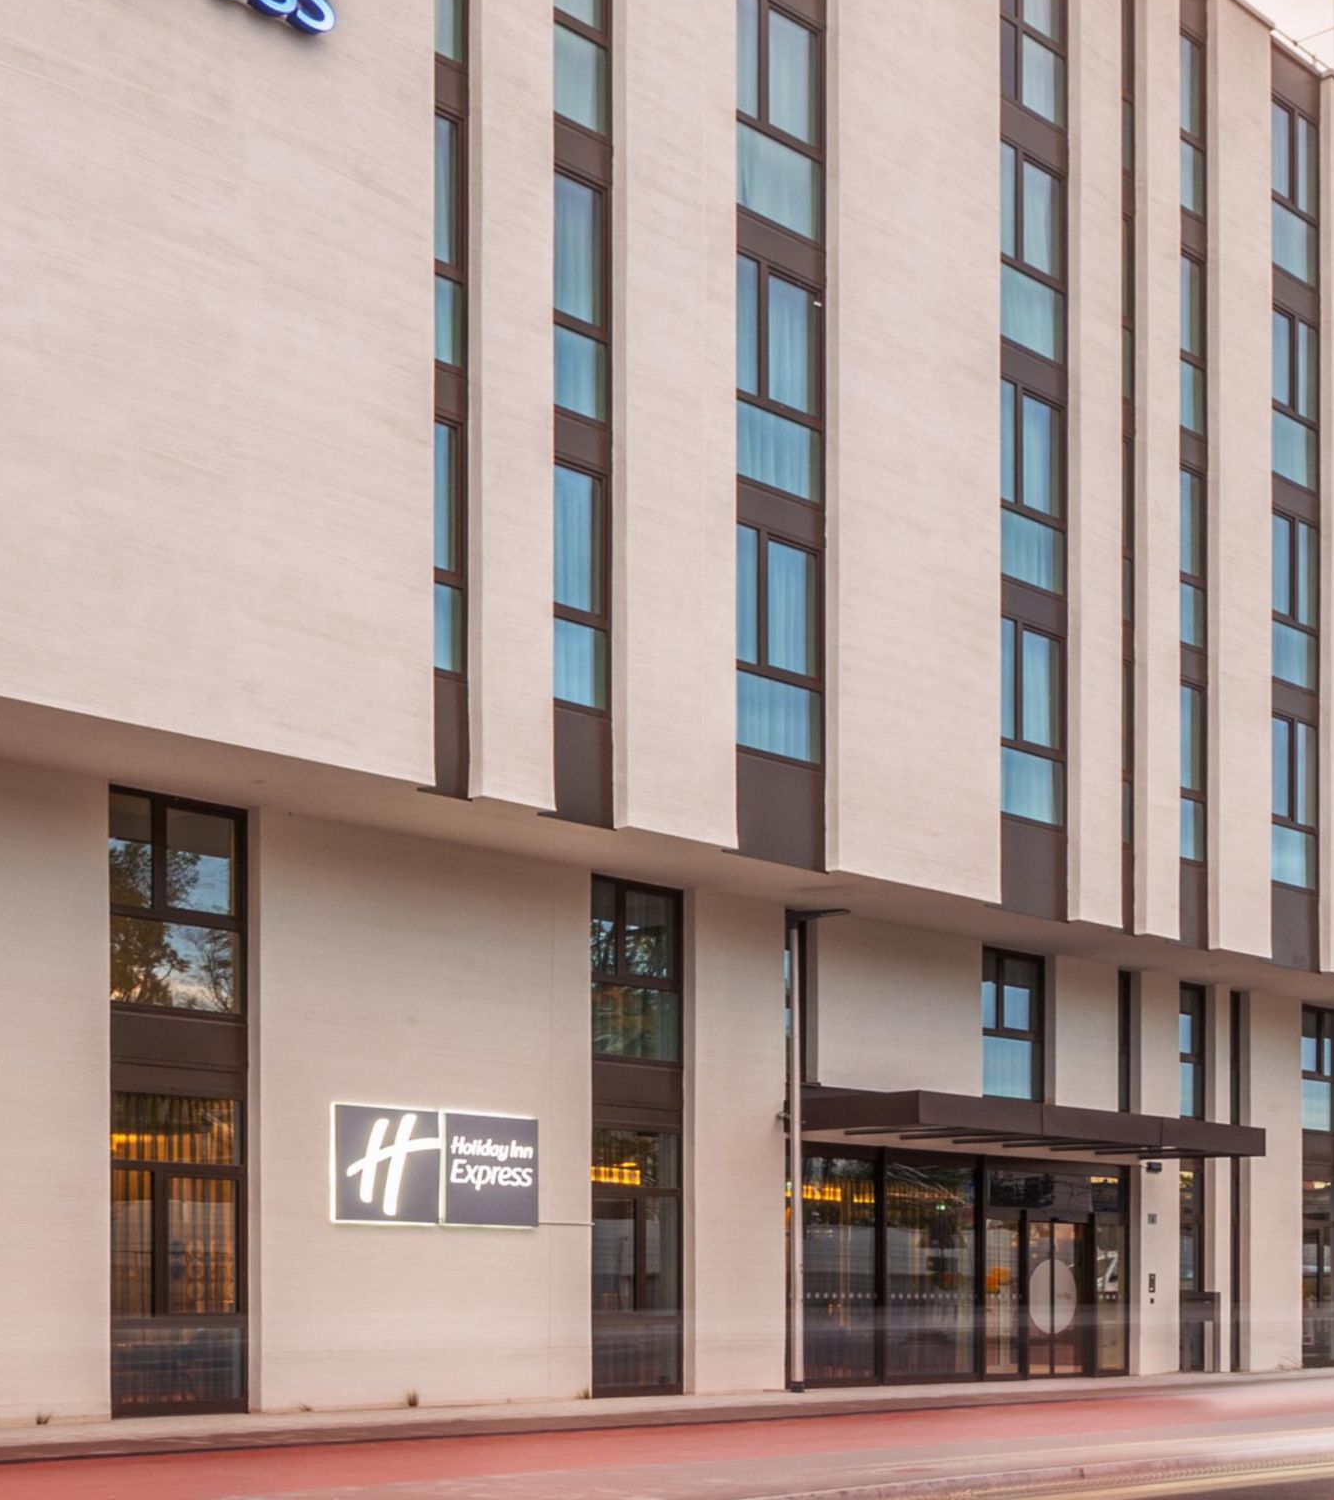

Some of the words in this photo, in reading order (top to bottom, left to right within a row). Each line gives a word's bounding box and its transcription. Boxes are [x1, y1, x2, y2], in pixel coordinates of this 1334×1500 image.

[449, 1134, 509, 1162] Holiday
[509, 1139, 534, 1160] Inn
[449, 1158, 534, 1192] Express
